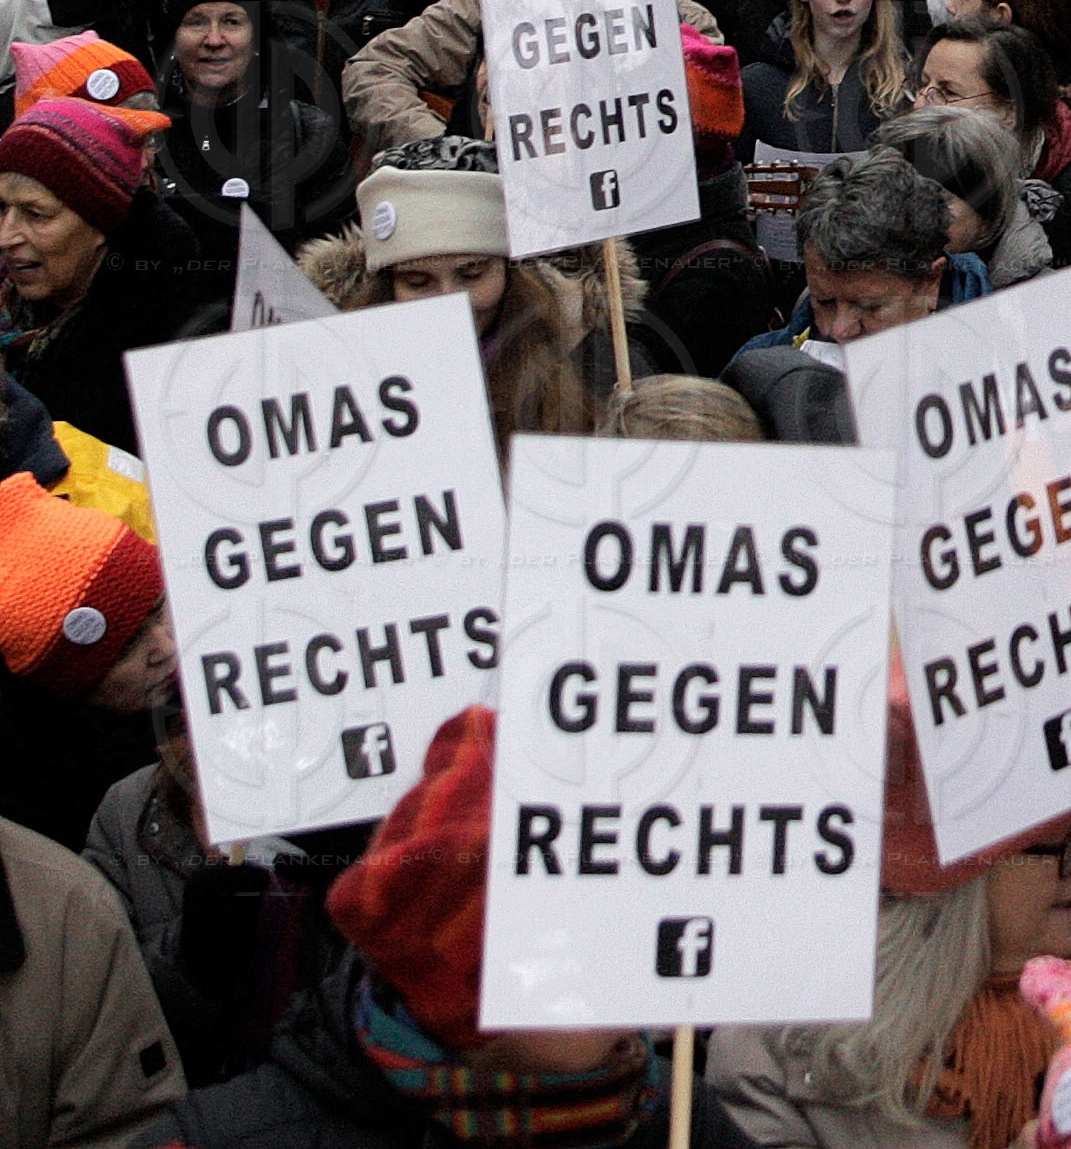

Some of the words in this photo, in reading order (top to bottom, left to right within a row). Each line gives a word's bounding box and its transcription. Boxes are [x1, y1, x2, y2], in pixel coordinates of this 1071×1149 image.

[511, 4, 658, 70] GEGEN
[509, 88, 679, 162] RECHTS
[207, 376, 420, 467] OMAS
[205, 491, 462, 590] GEGEN
[584, 522, 818, 597] OMAS
[202, 607, 499, 715] RECHTS
[549, 663, 836, 735] GEGEN
[516, 805, 854, 876] RECHTS
